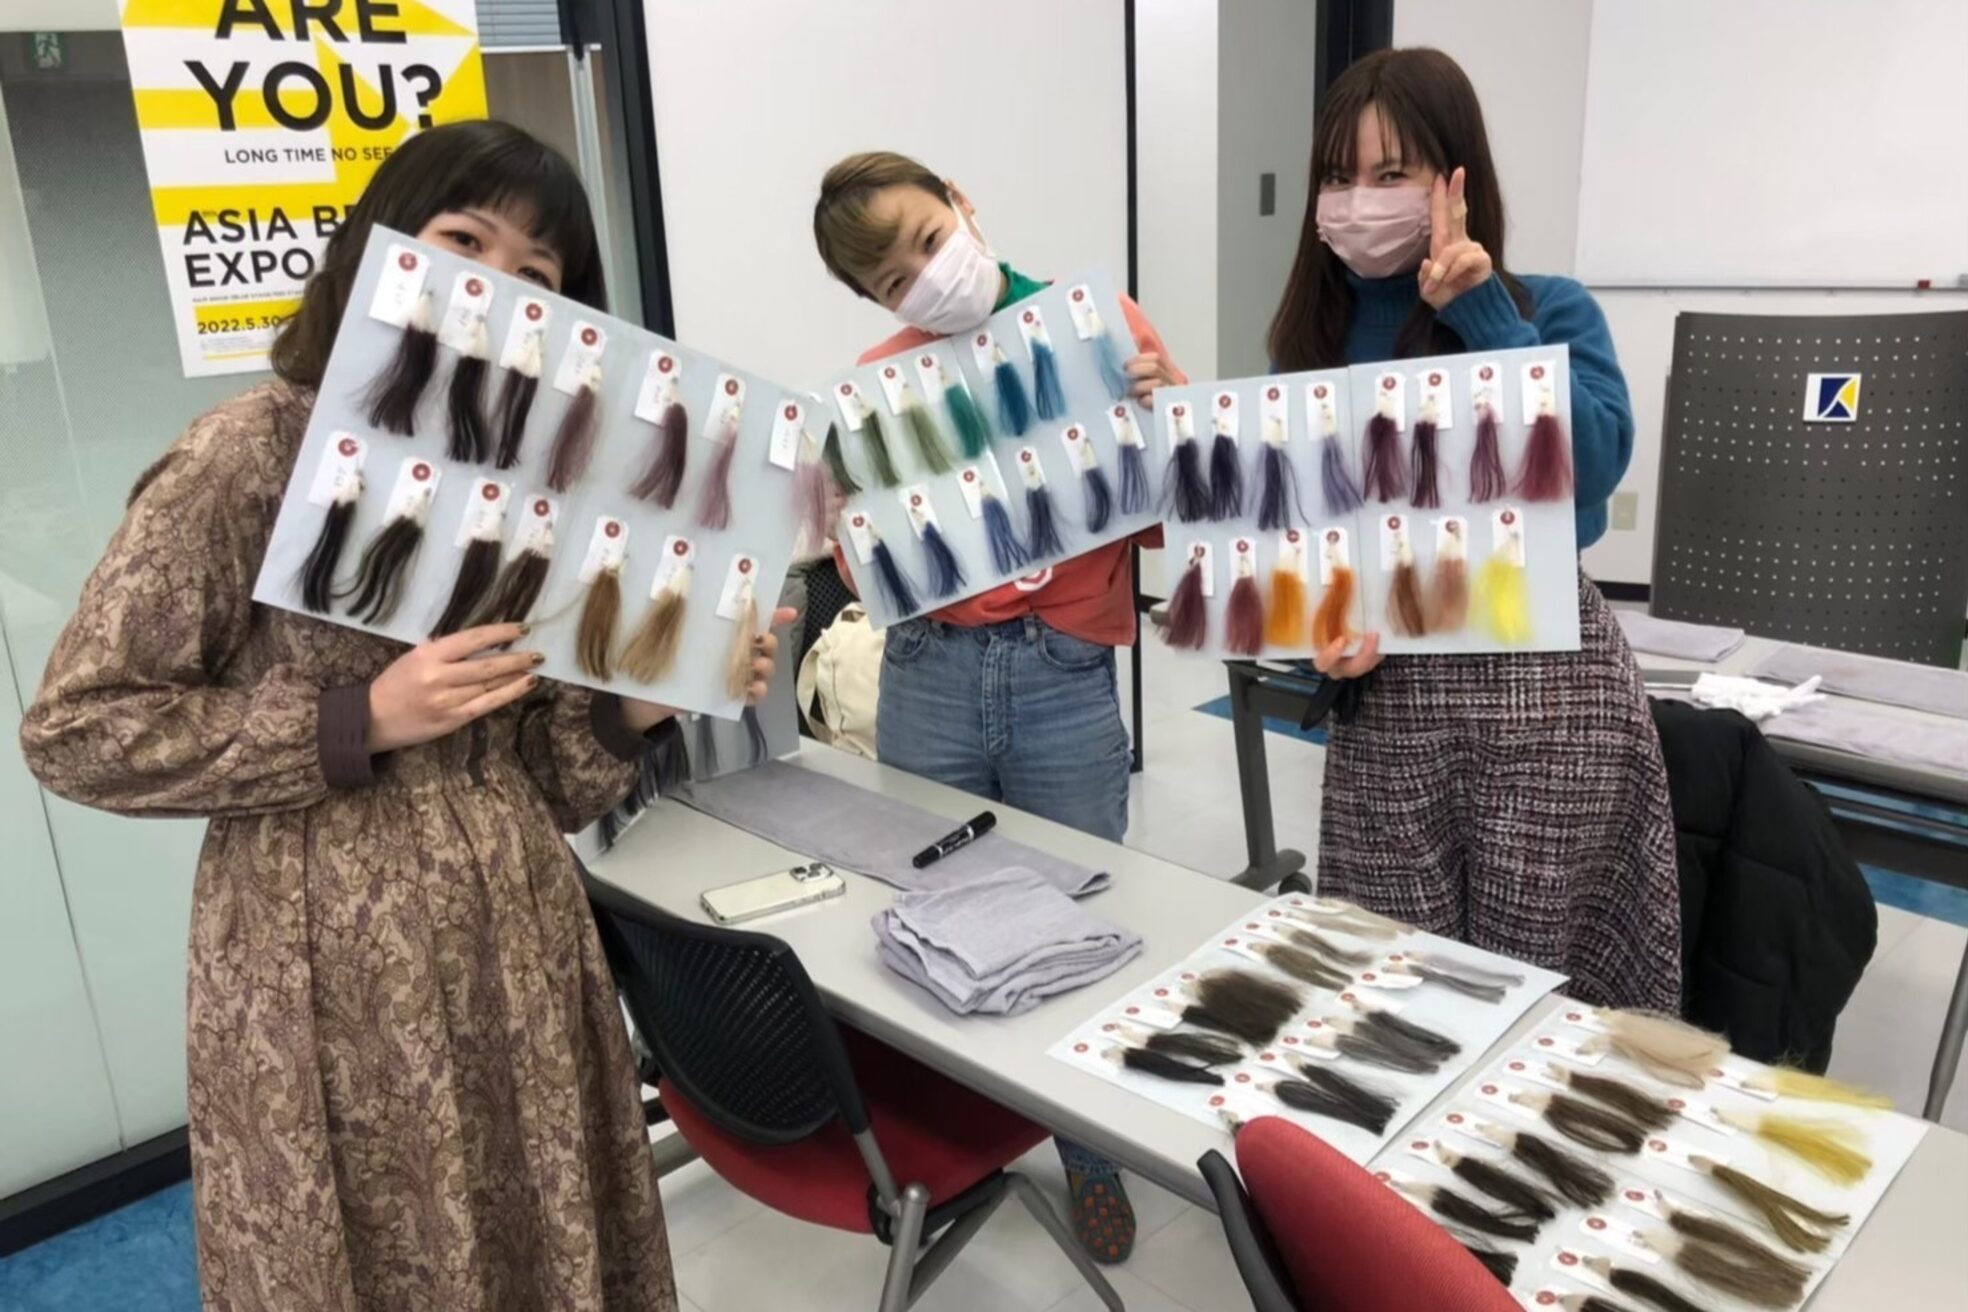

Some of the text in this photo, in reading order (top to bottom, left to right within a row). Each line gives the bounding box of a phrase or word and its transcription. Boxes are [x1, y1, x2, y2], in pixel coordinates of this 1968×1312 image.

[214, 0, 407, 44] ARE
[183, 60, 442, 131] YOU?
[224, 149, 278, 164] LONG
[286, 147, 326, 162] TIME
[331, 147, 357, 161] NO
[183, 203, 358, 245] ASIA B
[184, 247, 315, 288] EXPO
